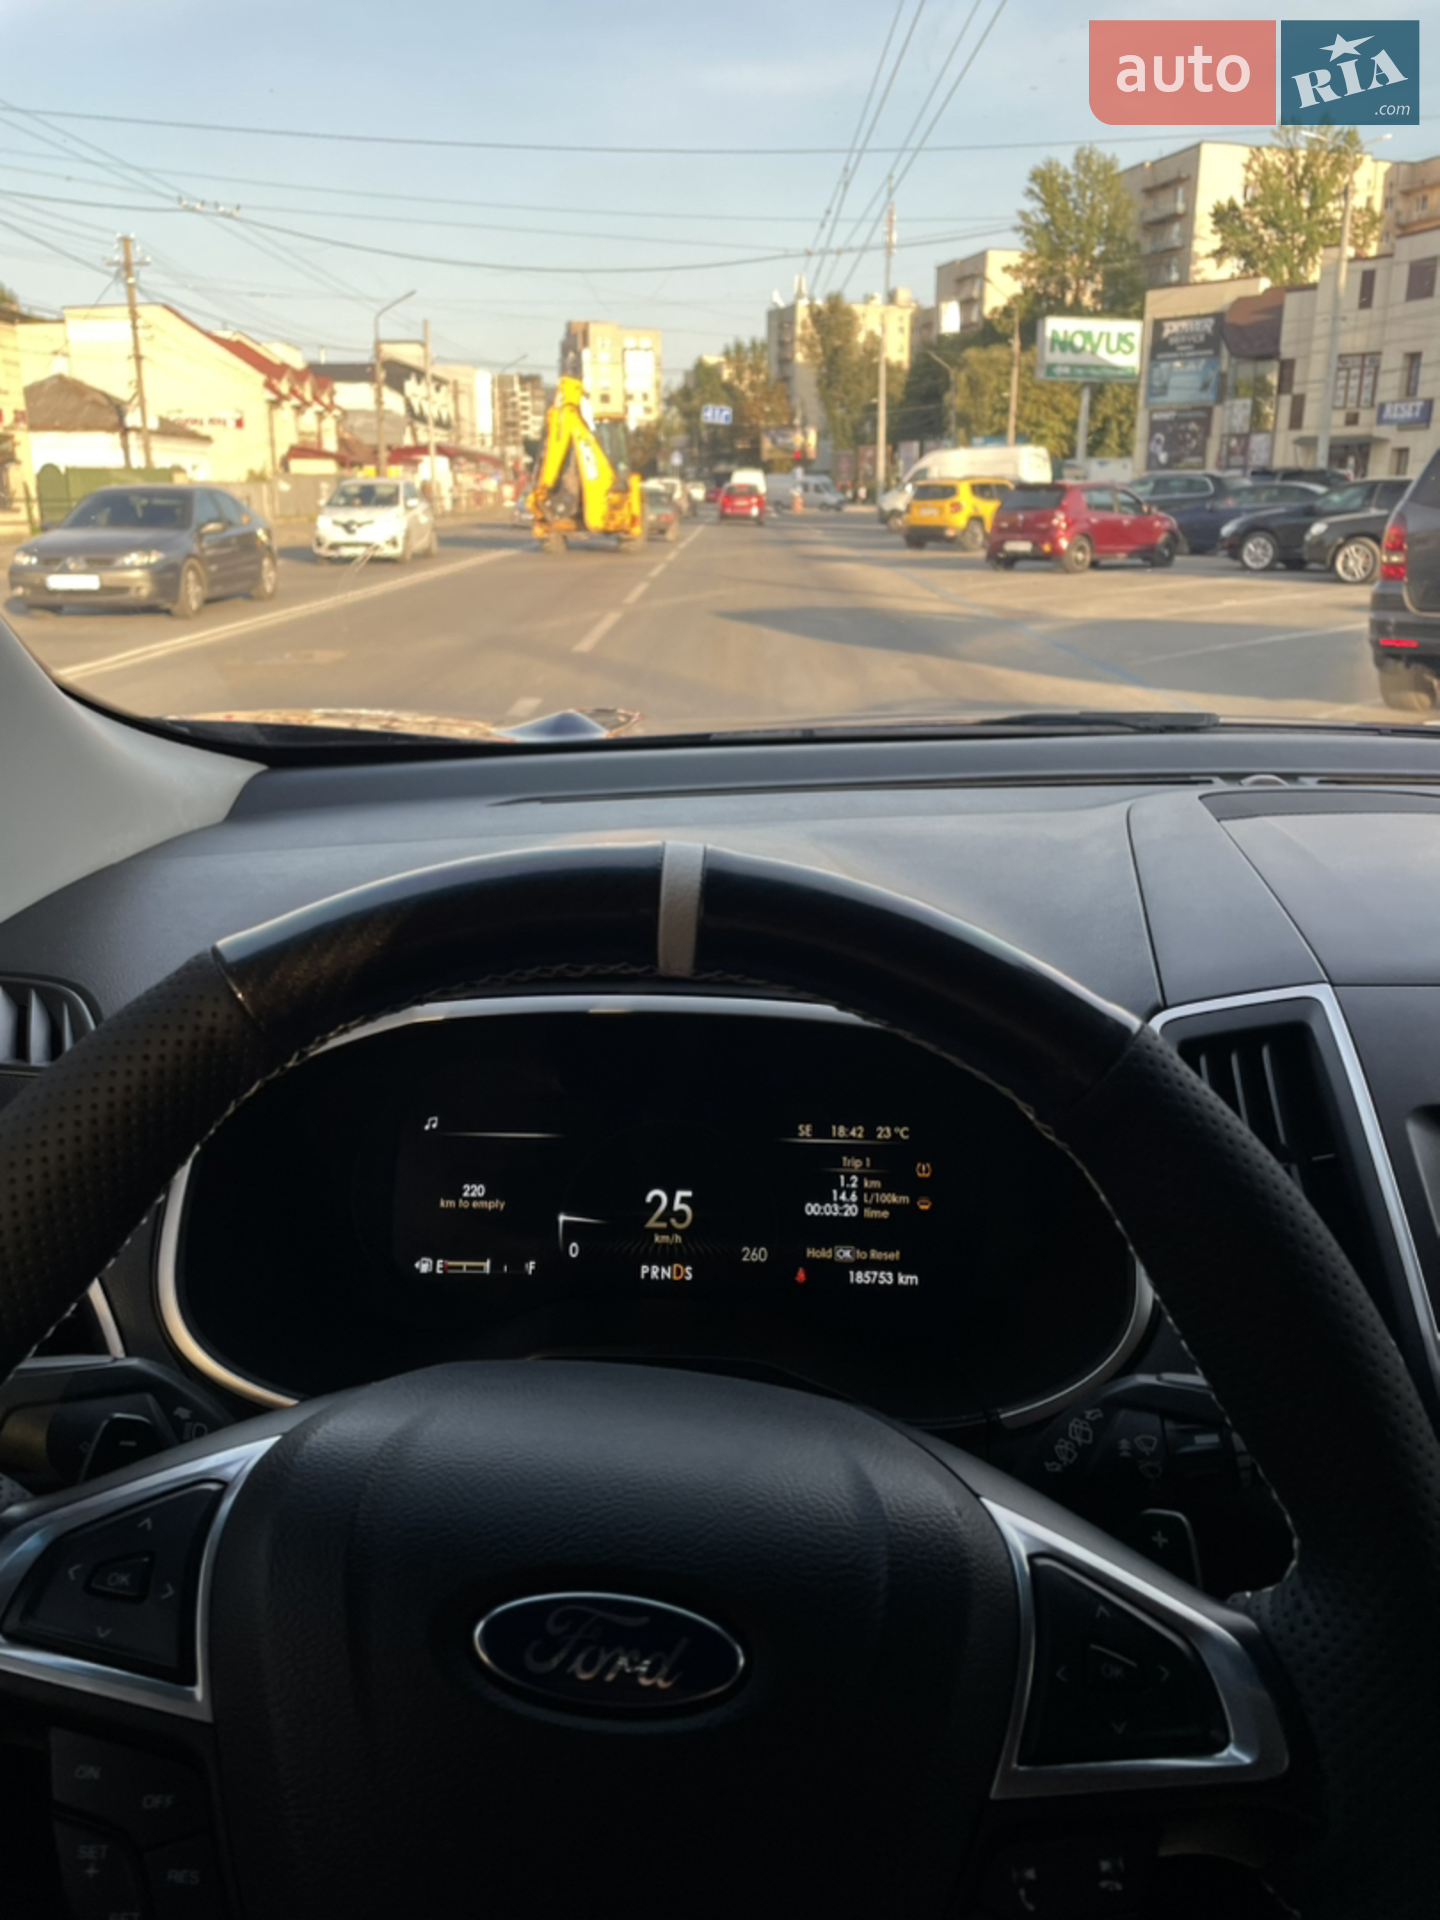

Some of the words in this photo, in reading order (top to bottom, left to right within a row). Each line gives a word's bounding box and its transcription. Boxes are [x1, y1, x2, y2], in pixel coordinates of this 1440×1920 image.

[1050, 328, 1136, 356] NOVUS
[797, 1123, 813, 1138] SE
[831, 1124, 865, 1139] 18:42
[875, 1126, 892, 1139] 23
[841, 1155, 864, 1169] Trip
[839, 1174, 859, 1189] 1.2
[863, 1177, 882, 1189] km
[461, 1183, 486, 1198] 220
[831, 1188, 858, 1203] 14.6
[439, 1198, 456, 1209] km
[458, 1198, 470, 1209] to
[471, 1199, 506, 1212] empty
[644, 1188, 694, 1230] 25
[804, 1202, 859, 1218] 00:03:20
[863, 1206, 890, 1219] time
[653, 1233, 682, 1245] km/h
[568, 1241, 580, 1258] 0
[740, 1246, 769, 1262] 260
[806, 1247, 833, 1260] Hold
[836, 1248, 853, 1260] OK
[856, 1248, 868, 1261] to
[869, 1248, 901, 1261] Reset
[435, 1258, 444, 1274] E
[639, 1262, 694, 1281] PRNDS
[848, 1269, 894, 1285] 185753
[897, 1271, 919, 1286] km
[106, 1571, 132, 1587] OK
[523, 1604, 690, 1689] Ford
[1101, 1662, 1125, 1680] OK
[74, 1764, 102, 1781] ON
[142, 1793, 177, 1810] OFF
[76, 1843, 109, 1861] SET
[166, 1867, 201, 1886] RES
